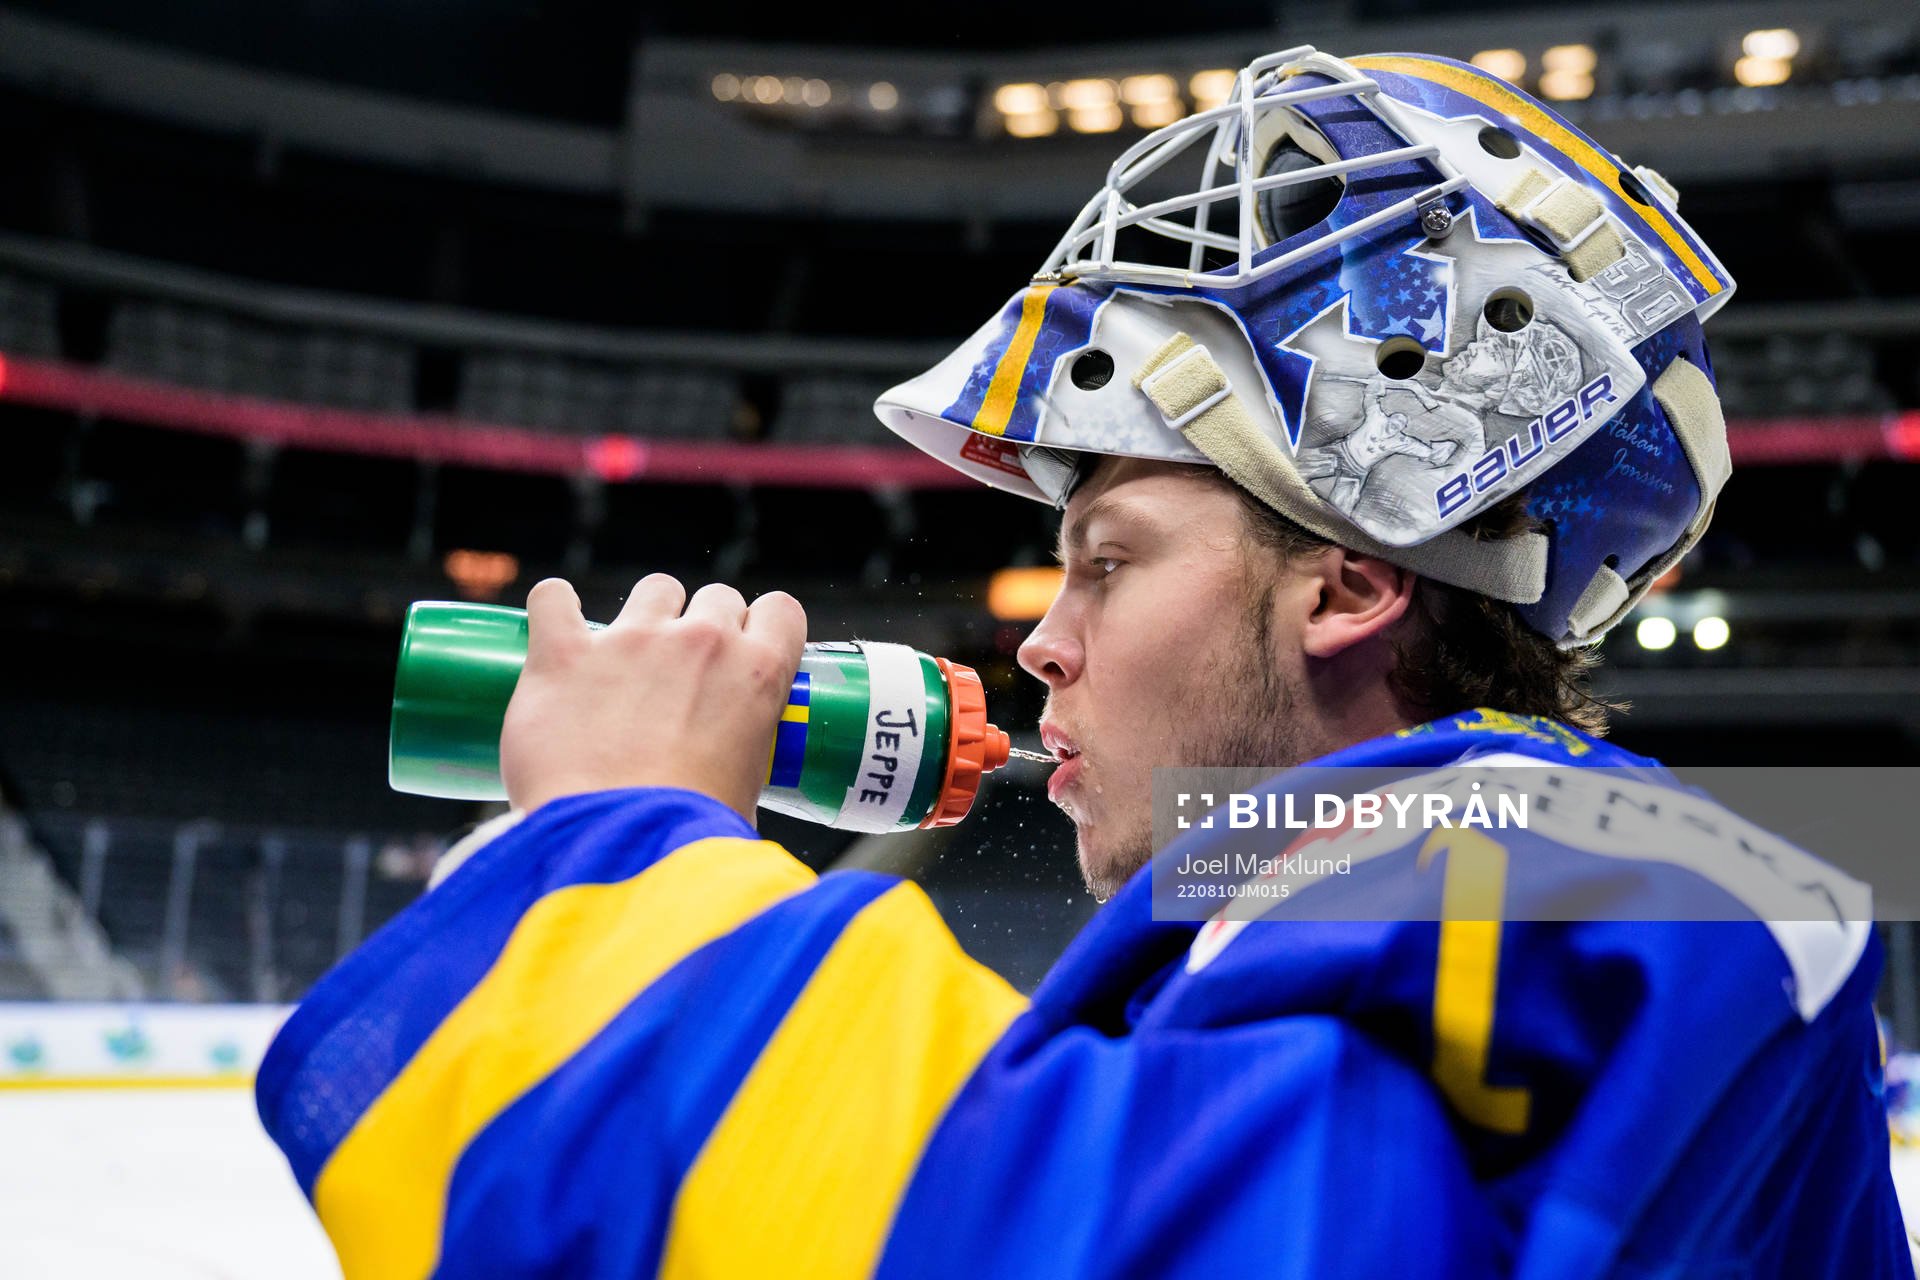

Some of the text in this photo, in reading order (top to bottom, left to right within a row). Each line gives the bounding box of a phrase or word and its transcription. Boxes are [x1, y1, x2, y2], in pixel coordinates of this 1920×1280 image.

[1591, 238, 1697, 338] 30
[1433, 372, 1619, 521] BAUER
[859, 708, 918, 806] JEPPE
